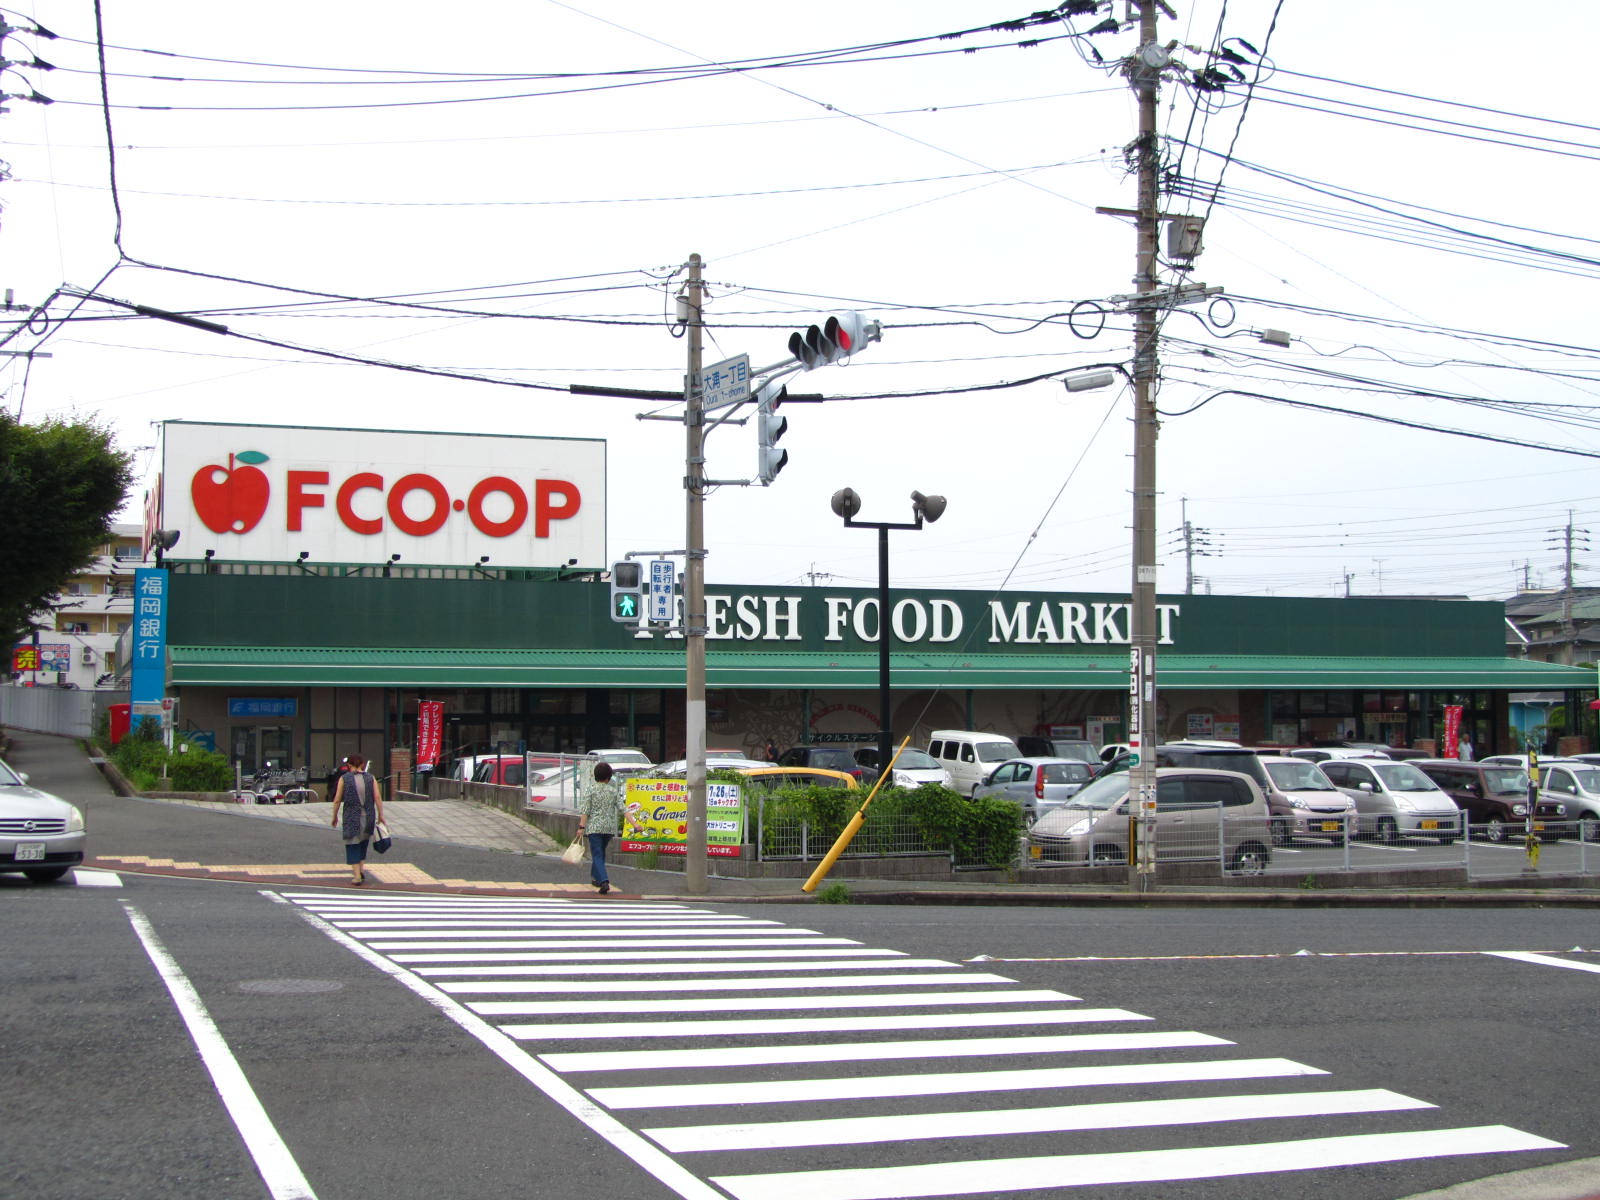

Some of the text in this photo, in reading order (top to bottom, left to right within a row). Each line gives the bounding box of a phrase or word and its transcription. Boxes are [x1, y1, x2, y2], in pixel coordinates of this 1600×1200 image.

[704, 362, 746, 392] 大浦一丁目
[652, 564, 662, 593] 自転車
[663, 564, 672, 593] 歩行者
[139, 576, 163, 658] 福岡銀行
[658, 595, 667, 617] 専用
[824, 597, 963, 643] FOOD
[988, 600, 1180, 645] MARKT
[248, 702, 295, 713] 福岡銀行
